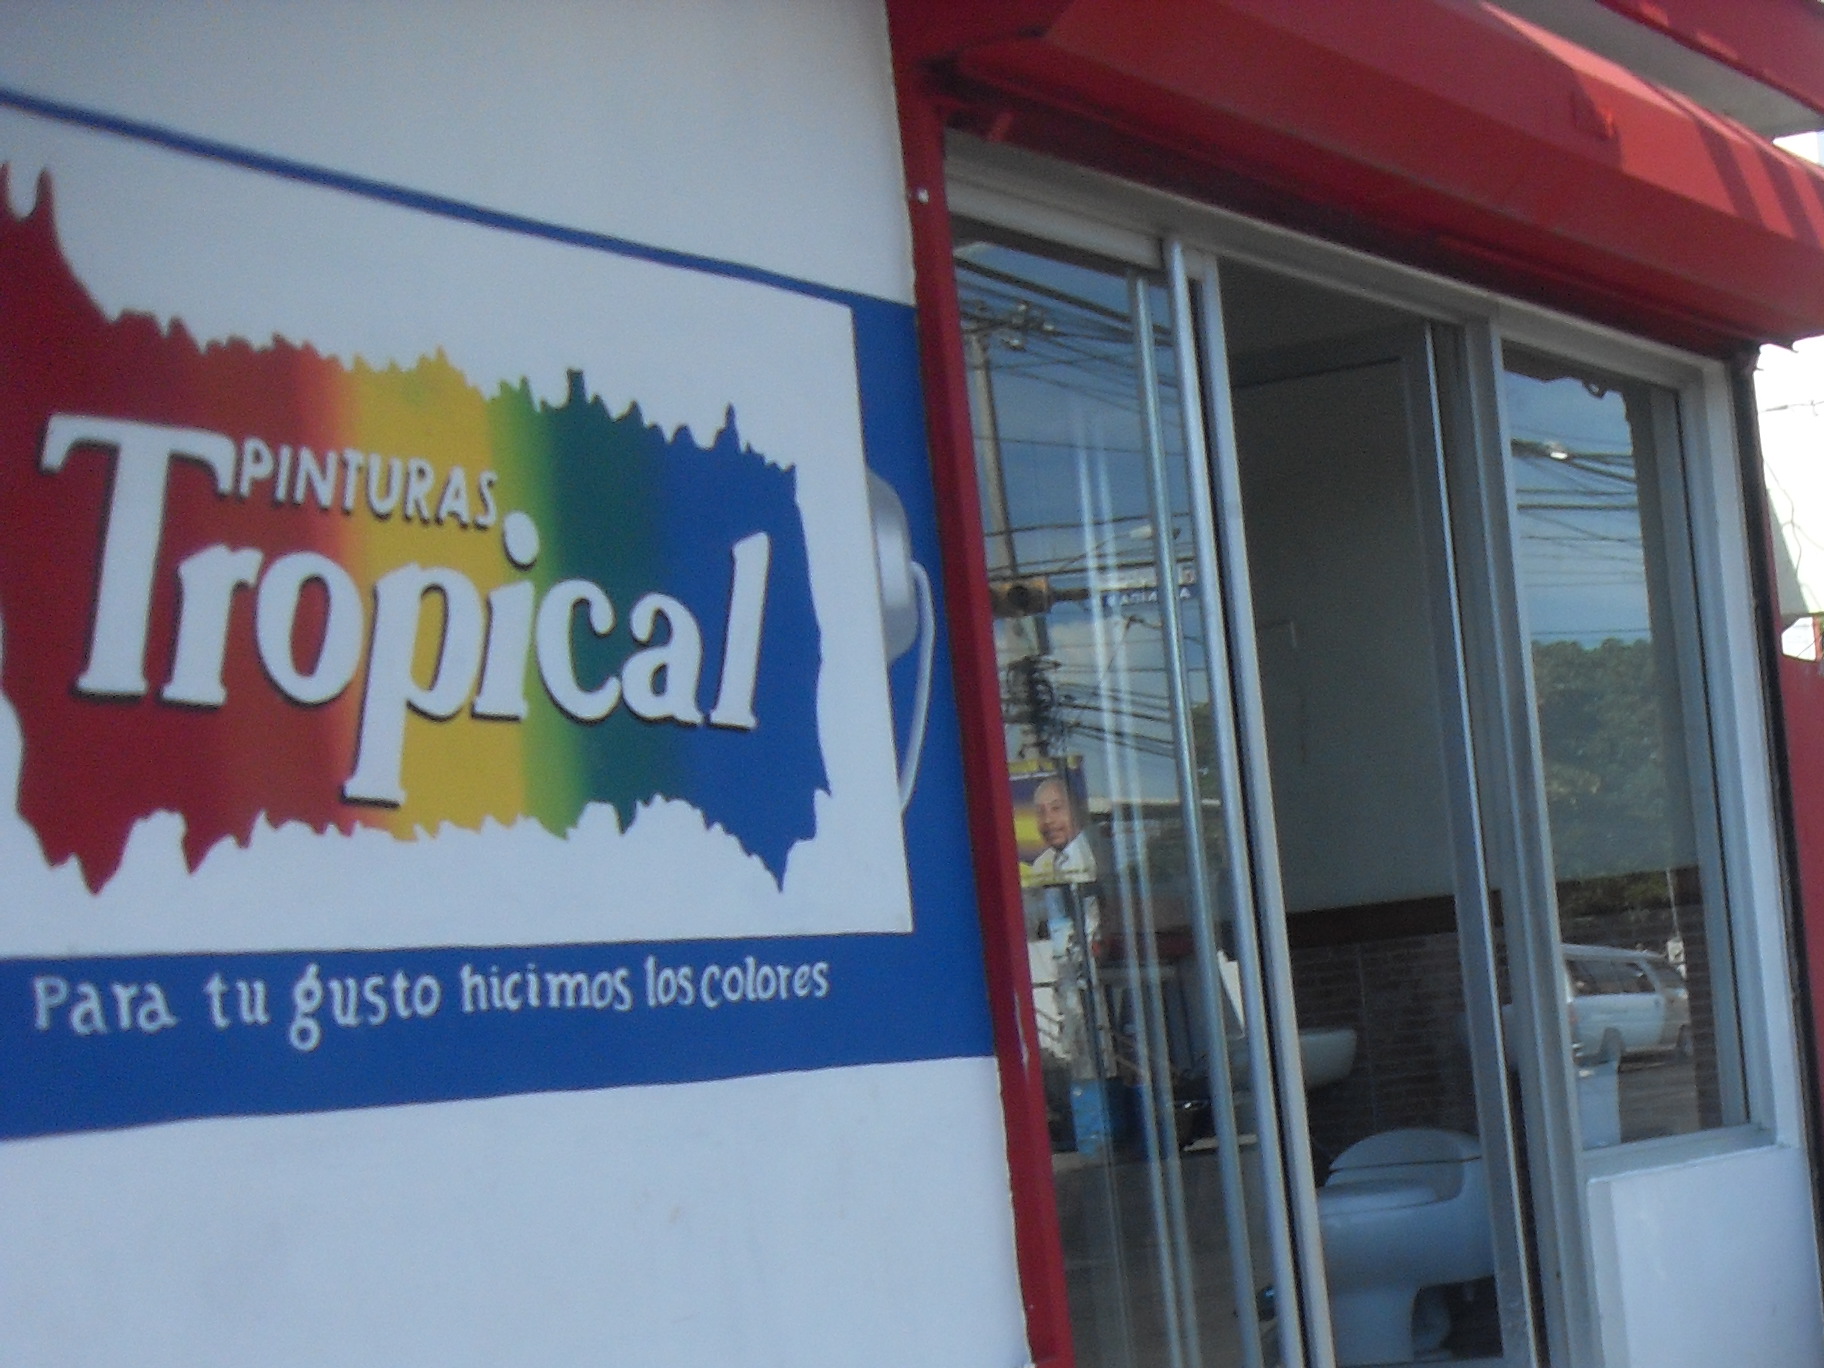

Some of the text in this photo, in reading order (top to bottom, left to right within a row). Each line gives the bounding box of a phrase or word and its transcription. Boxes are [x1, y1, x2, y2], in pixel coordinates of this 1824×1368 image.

[238, 438, 499, 529] PINTURAS
[41, 413, 770, 806] Tropical
[33, 954, 830, 1052] Para tu gusto hicimos los colores
